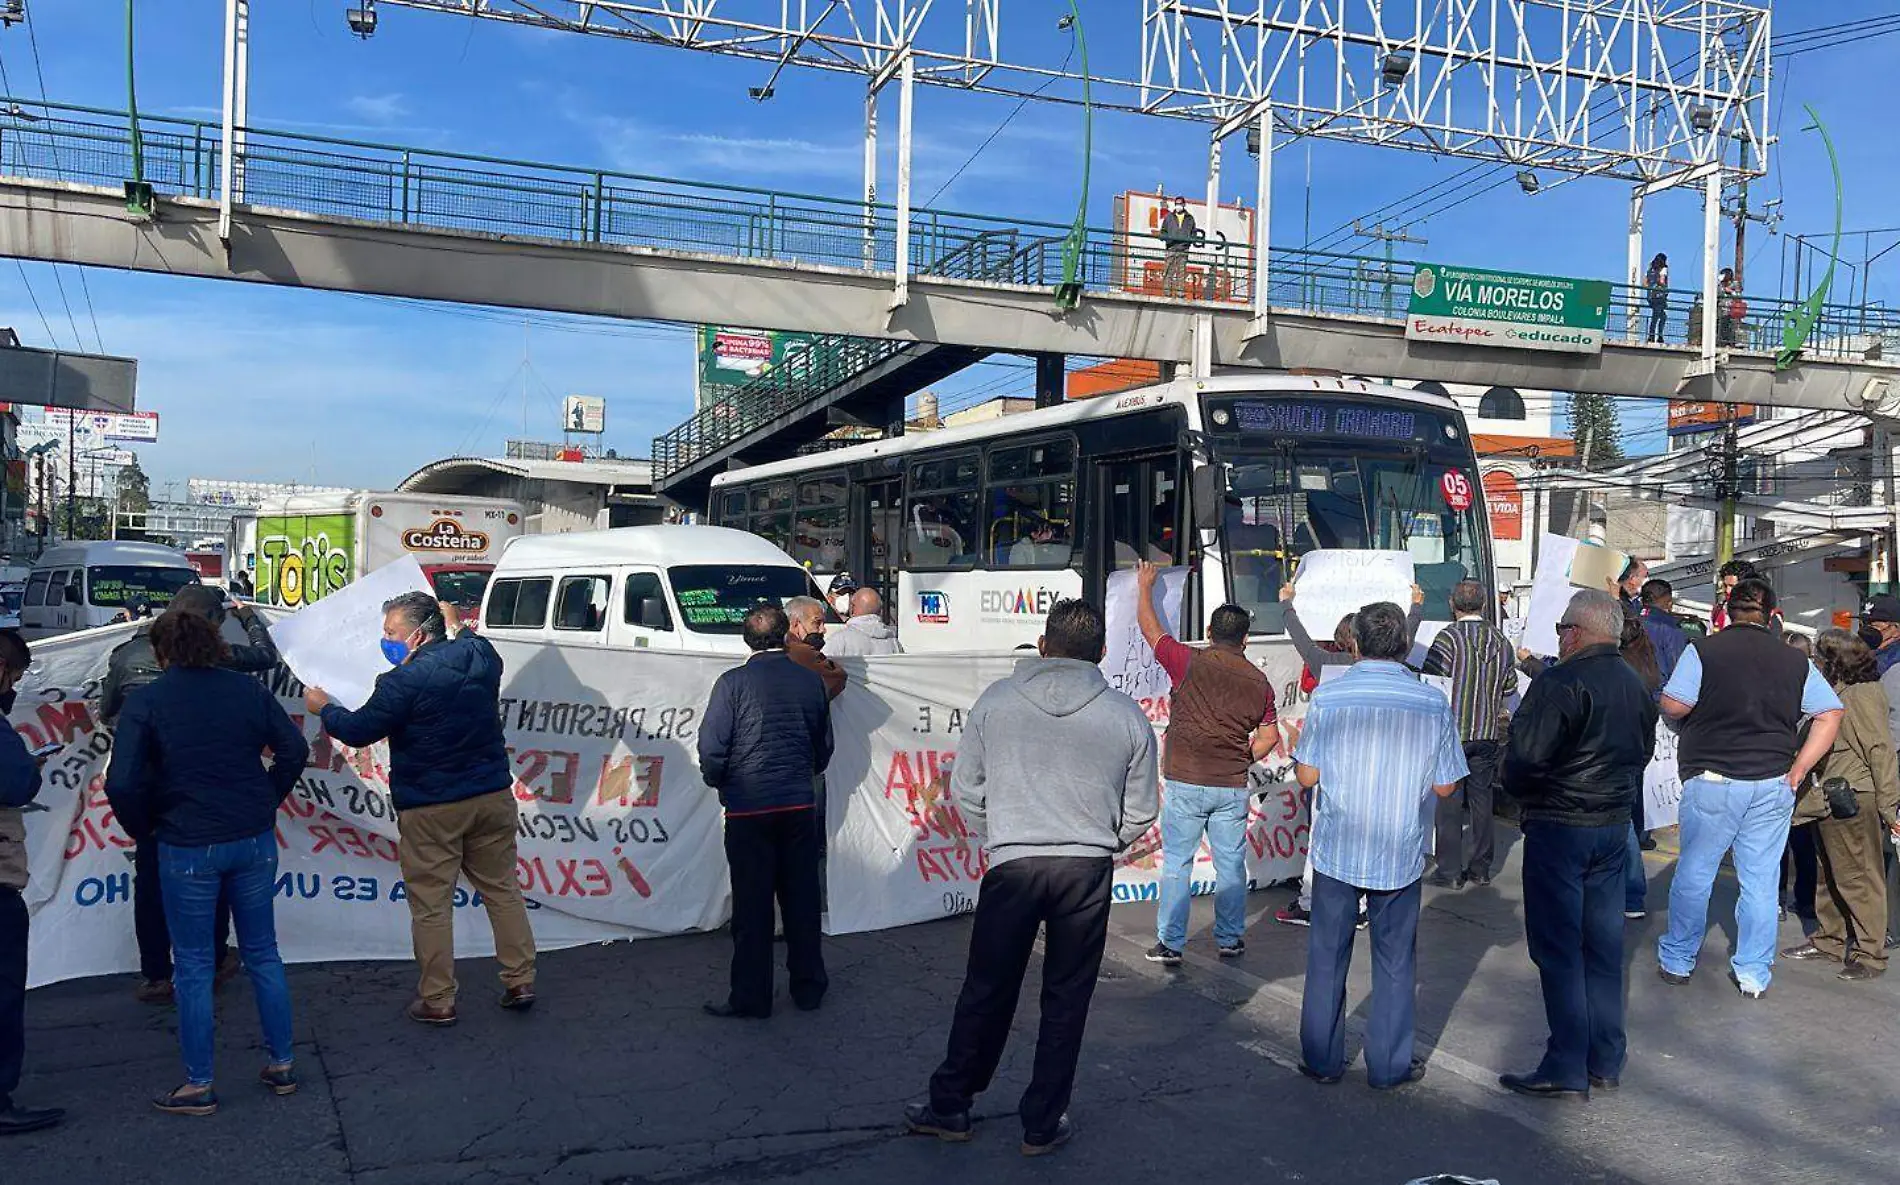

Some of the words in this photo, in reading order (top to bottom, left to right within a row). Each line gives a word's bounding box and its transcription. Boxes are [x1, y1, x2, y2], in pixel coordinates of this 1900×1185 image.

[1445, 279, 1473, 303] VÍA
[1477, 285, 1565, 311] MORELOS
[1452, 306, 1487, 319] COLONIA
[1487, 309, 1537, 322] BOULEVARES
[1537, 313, 1565, 325] IMPALA
[1414, 319, 1495, 338] Ecatepec
[1517, 331, 1593, 345] educado
[1443, 473, 1467, 494] 05
[439, 523, 455, 535] La
[410, 533, 481, 549] Costeña
[262, 534, 347, 607] Totis
